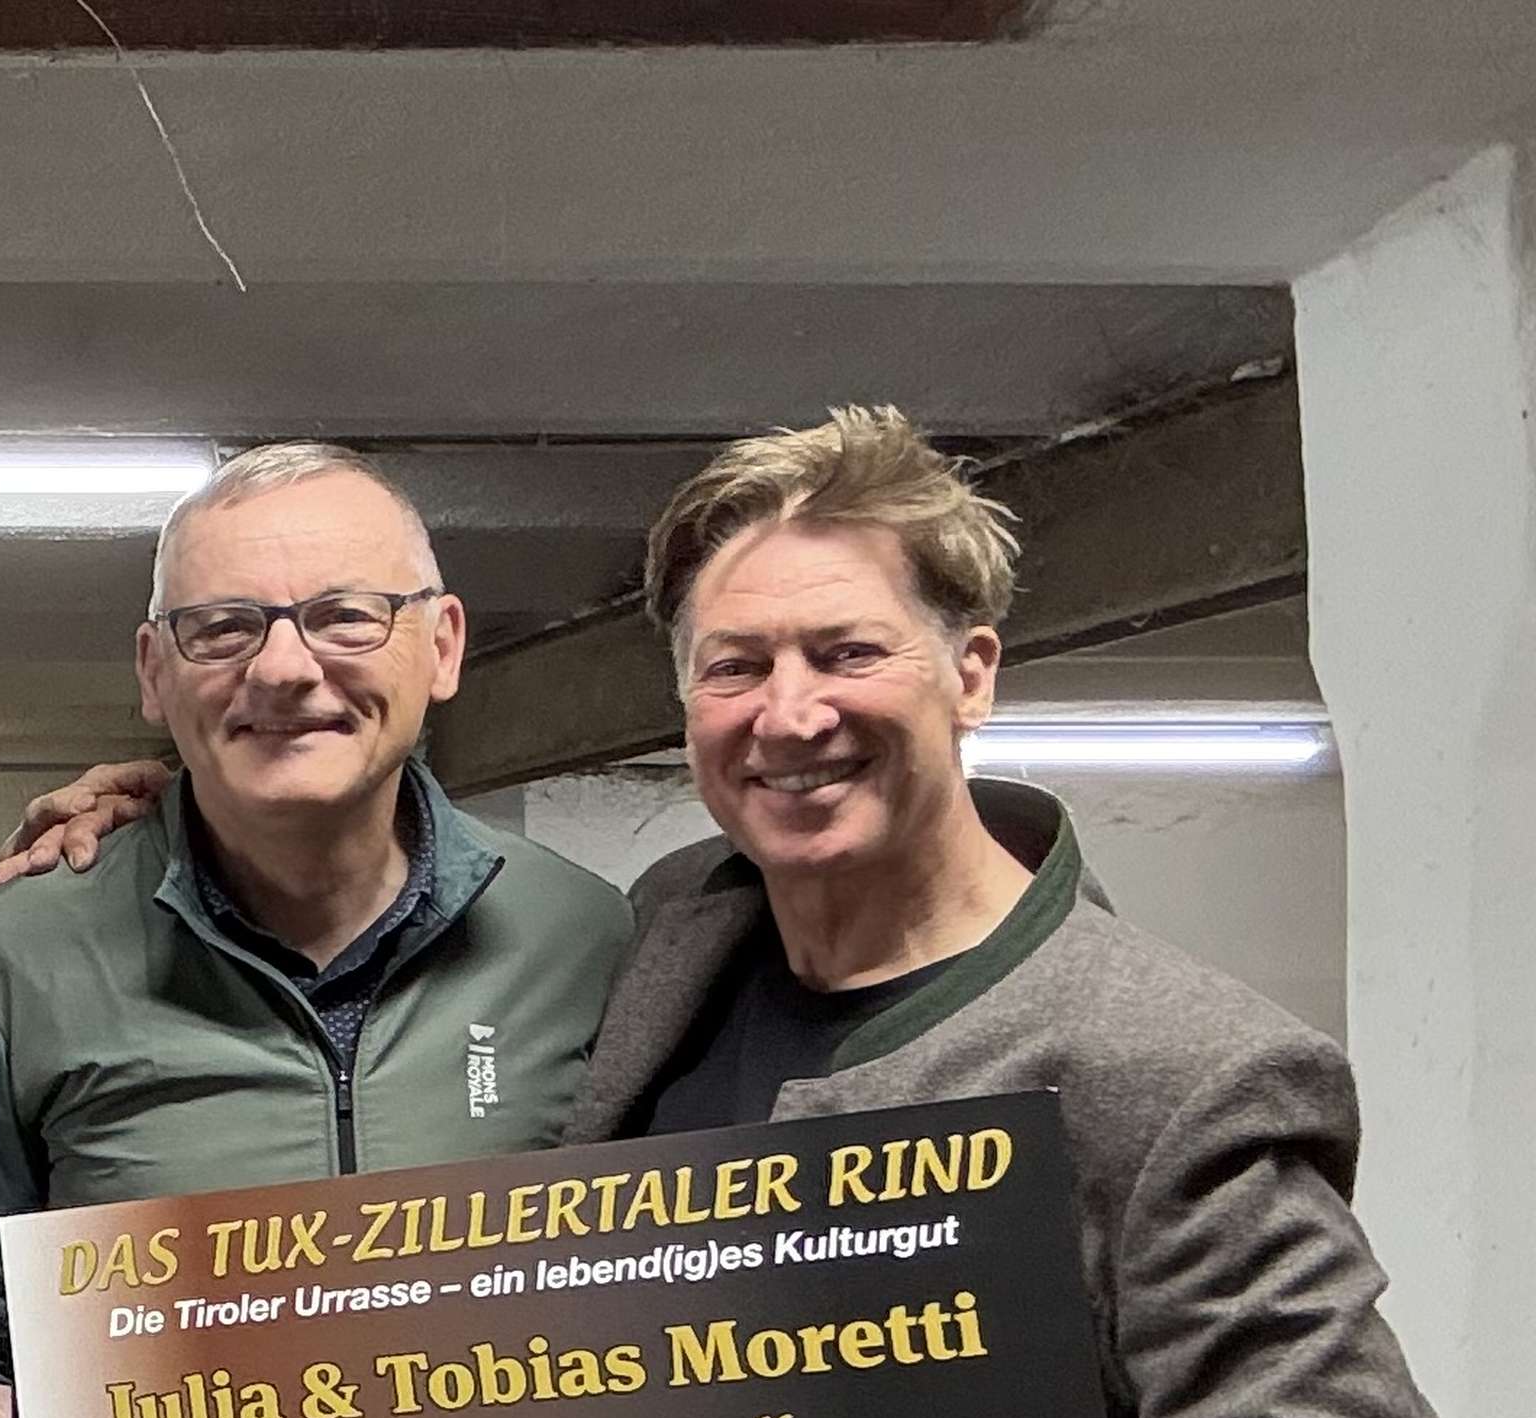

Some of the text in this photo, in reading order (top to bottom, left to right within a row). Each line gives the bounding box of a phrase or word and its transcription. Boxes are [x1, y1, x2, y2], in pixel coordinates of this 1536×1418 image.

[467, 1054, 485, 1118] ROYALE
[482, 1056, 499, 1104] MONS
[59, 1128, 1014, 1295] DAS TUX-ZILLERTALER RIND
[110, 1305, 164, 1338] Die
[174, 1294, 286, 1331] Tiroler
[294, 1279, 431, 1318] Urrasse
[471, 1264, 525, 1298] ein
[537, 1238, 764, 1292] lebend(ig)es
[774, 1214, 960, 1265] Kulturgut
[375, 1335, 647, 1415] Tobias
[665, 1291, 988, 1387] Moretti
